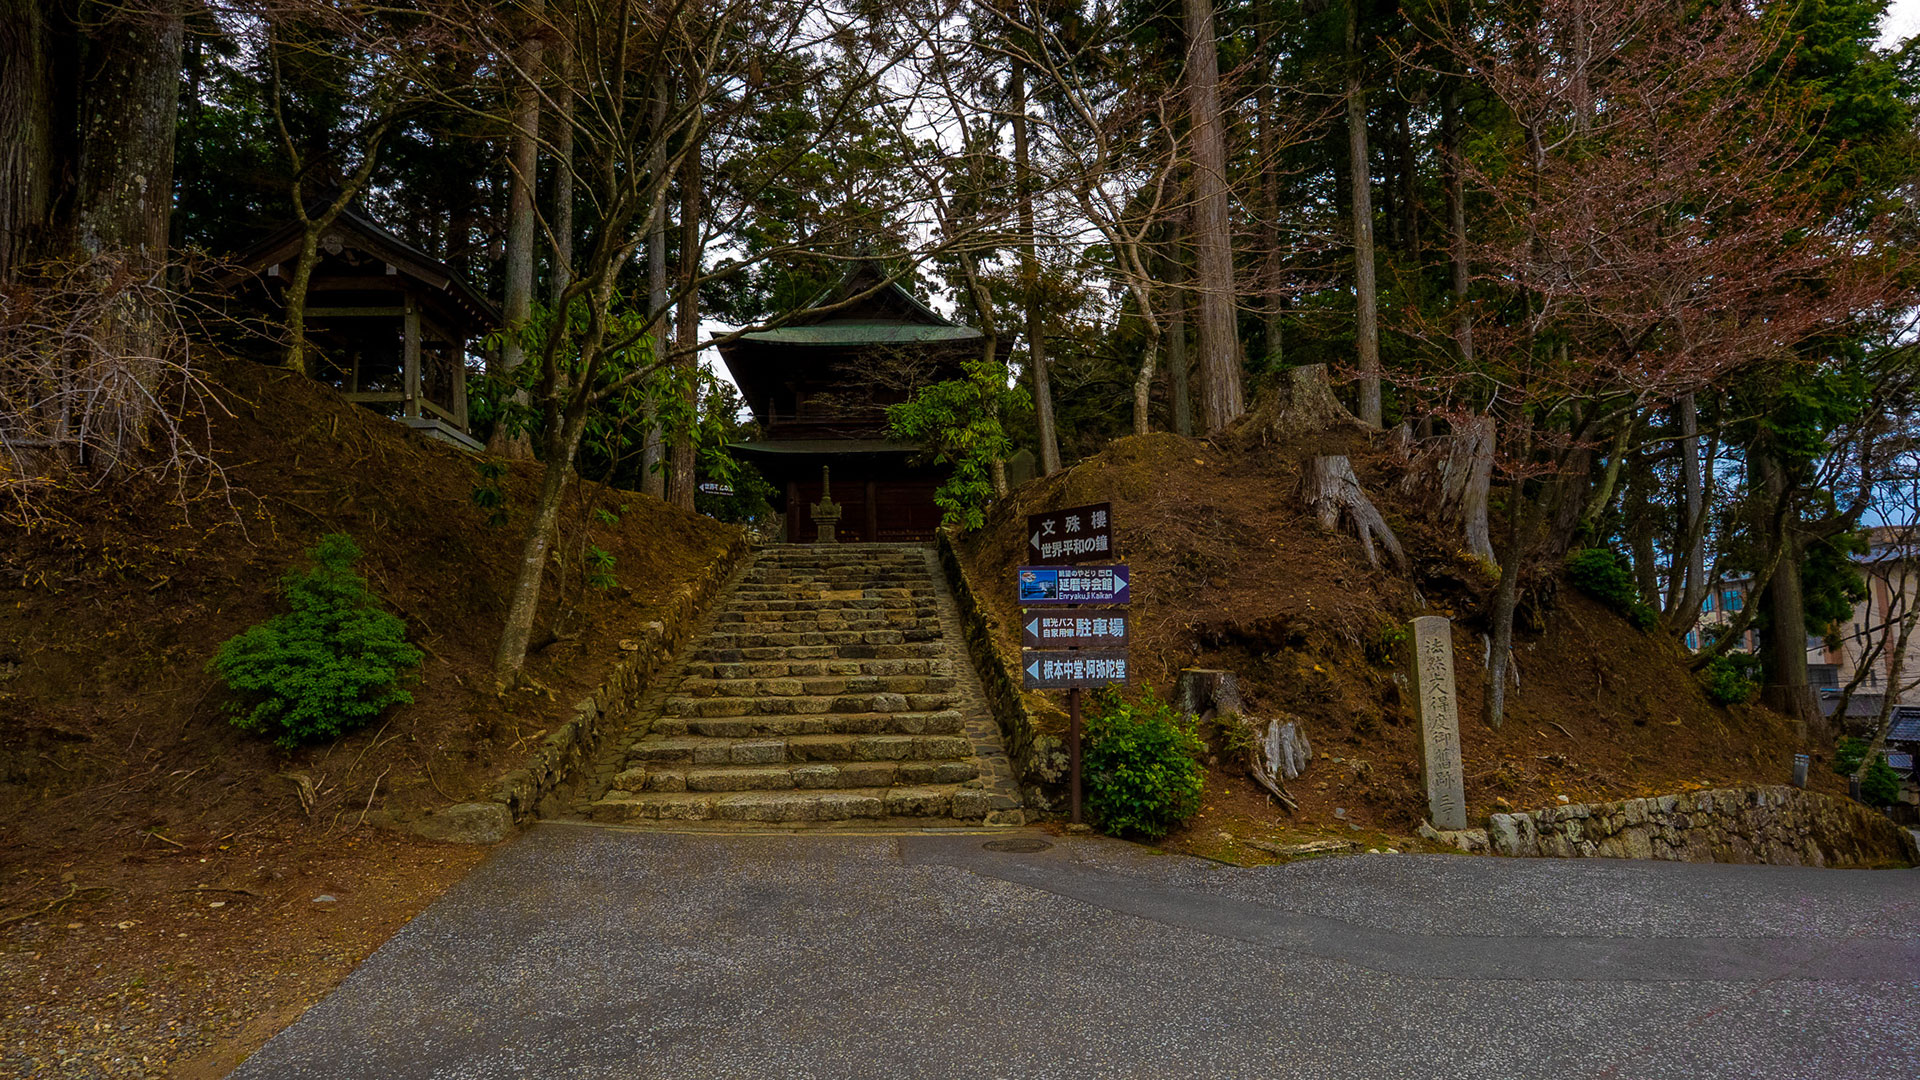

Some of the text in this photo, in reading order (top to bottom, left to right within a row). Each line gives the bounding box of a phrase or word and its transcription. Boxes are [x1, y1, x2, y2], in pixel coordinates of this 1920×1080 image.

[1041, 510, 1107, 536] 文殊樓
[1041, 534, 1108, 559] 世界平和の鐘
[1042, 618, 1074, 627] 観光バス
[1076, 618, 1124, 637] 駐車場
[1042, 628, 1074, 638] 自家用車
